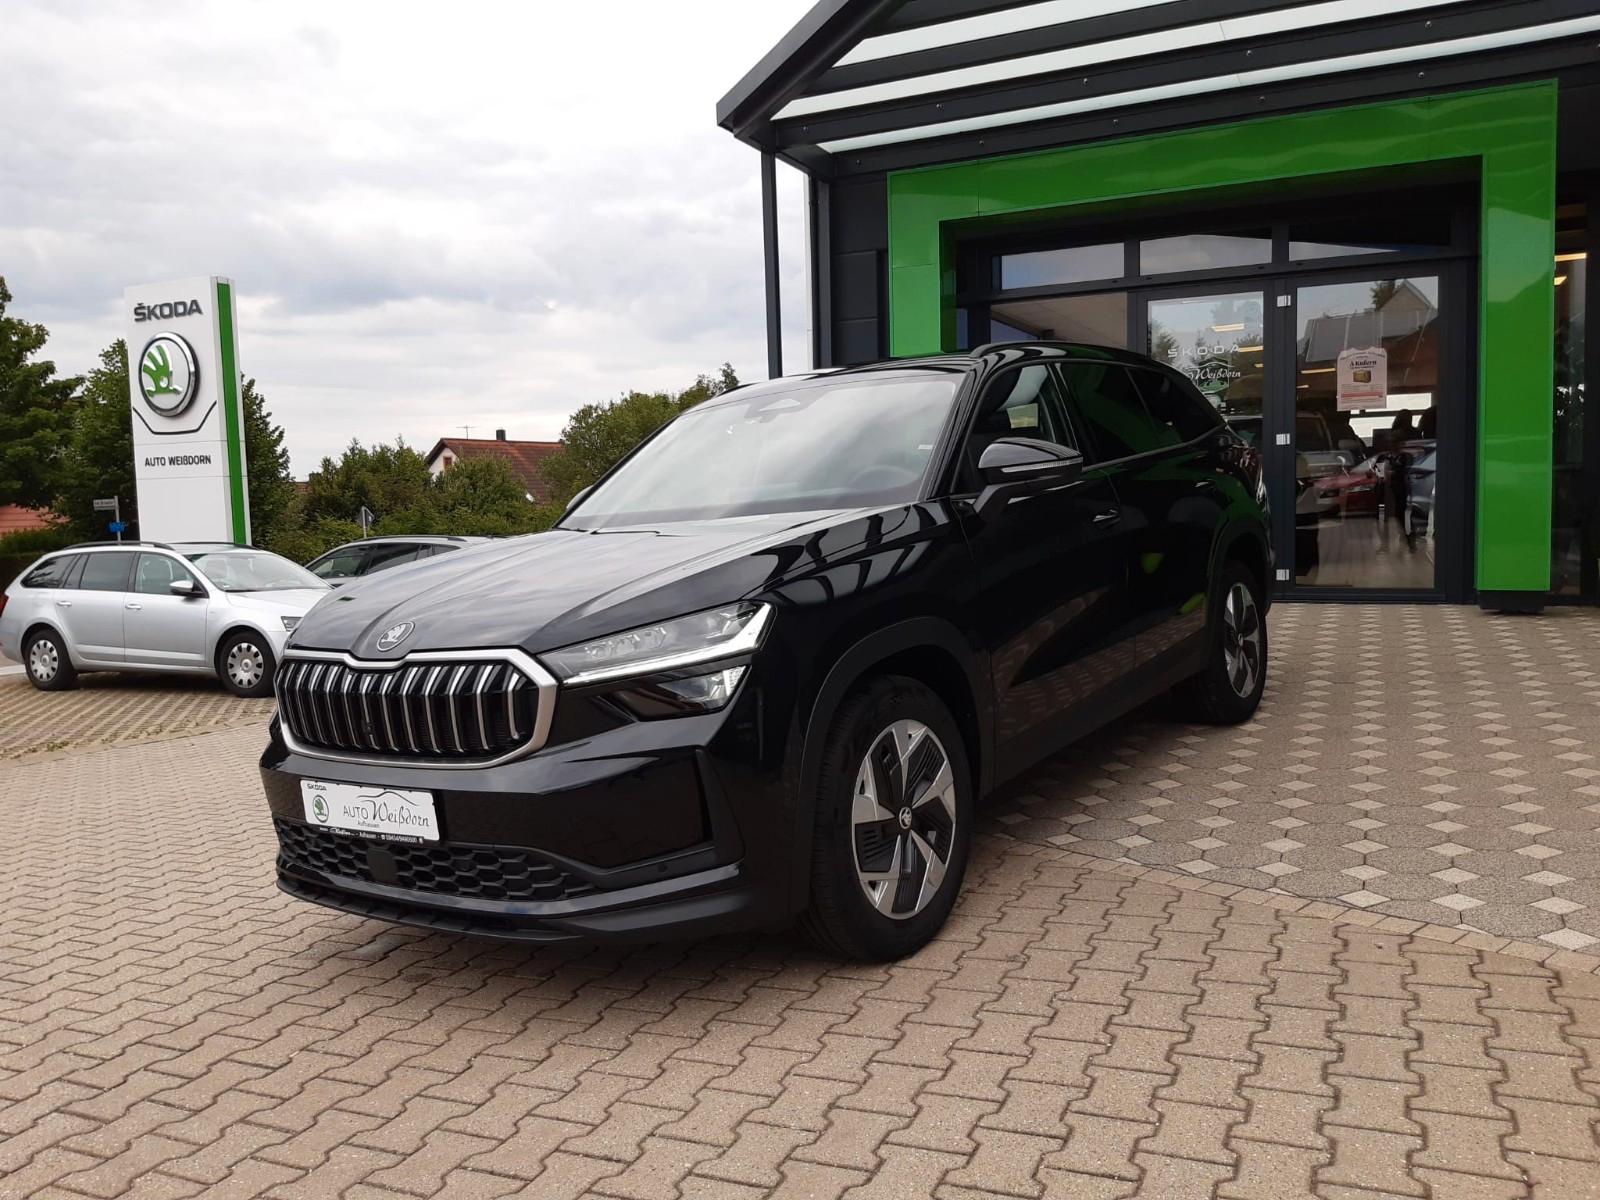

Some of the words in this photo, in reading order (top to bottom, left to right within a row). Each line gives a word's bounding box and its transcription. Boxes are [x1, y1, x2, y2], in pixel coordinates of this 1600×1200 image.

[134, 299, 203, 322] ŠKODA
[145, 456, 166, 467] AUTO
[343, 804, 369, 820] AUTO
[361, 800, 430, 828] Weißdorn
